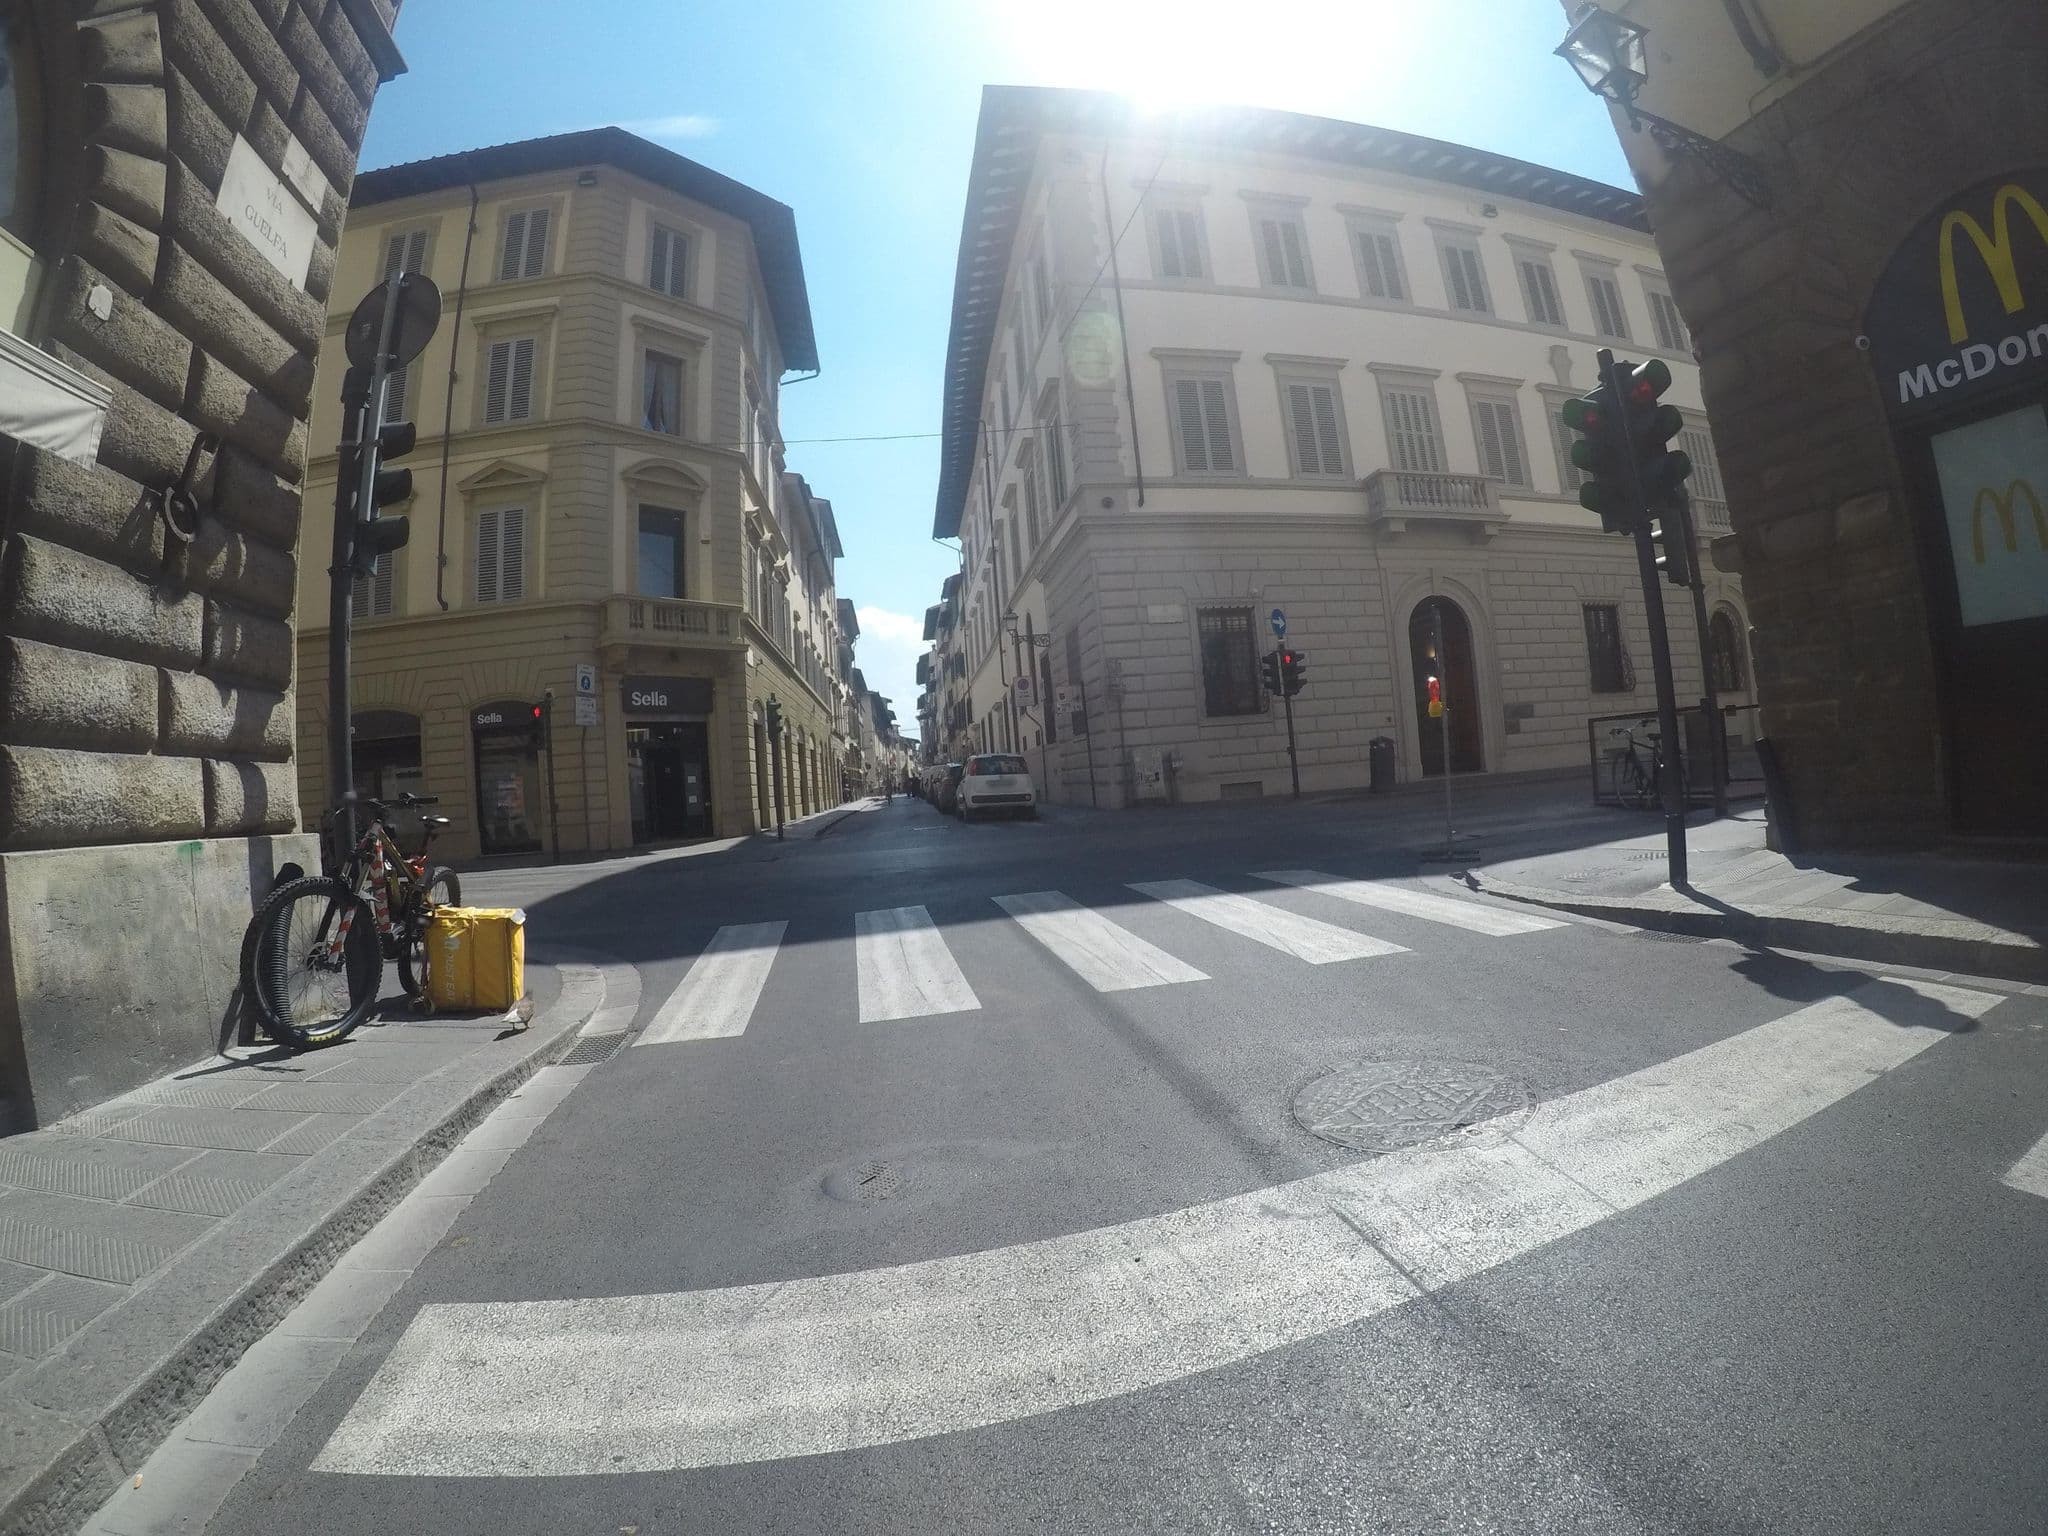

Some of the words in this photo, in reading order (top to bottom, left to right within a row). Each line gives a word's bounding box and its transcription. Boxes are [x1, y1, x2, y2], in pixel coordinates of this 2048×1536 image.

[266, 187, 283, 216] VIA
[244, 204, 288, 259] GUELFA
[1898, 323, 2048, 404] McDon
[631, 691, 668, 706] Sella
[477, 712, 502, 724] Sella
